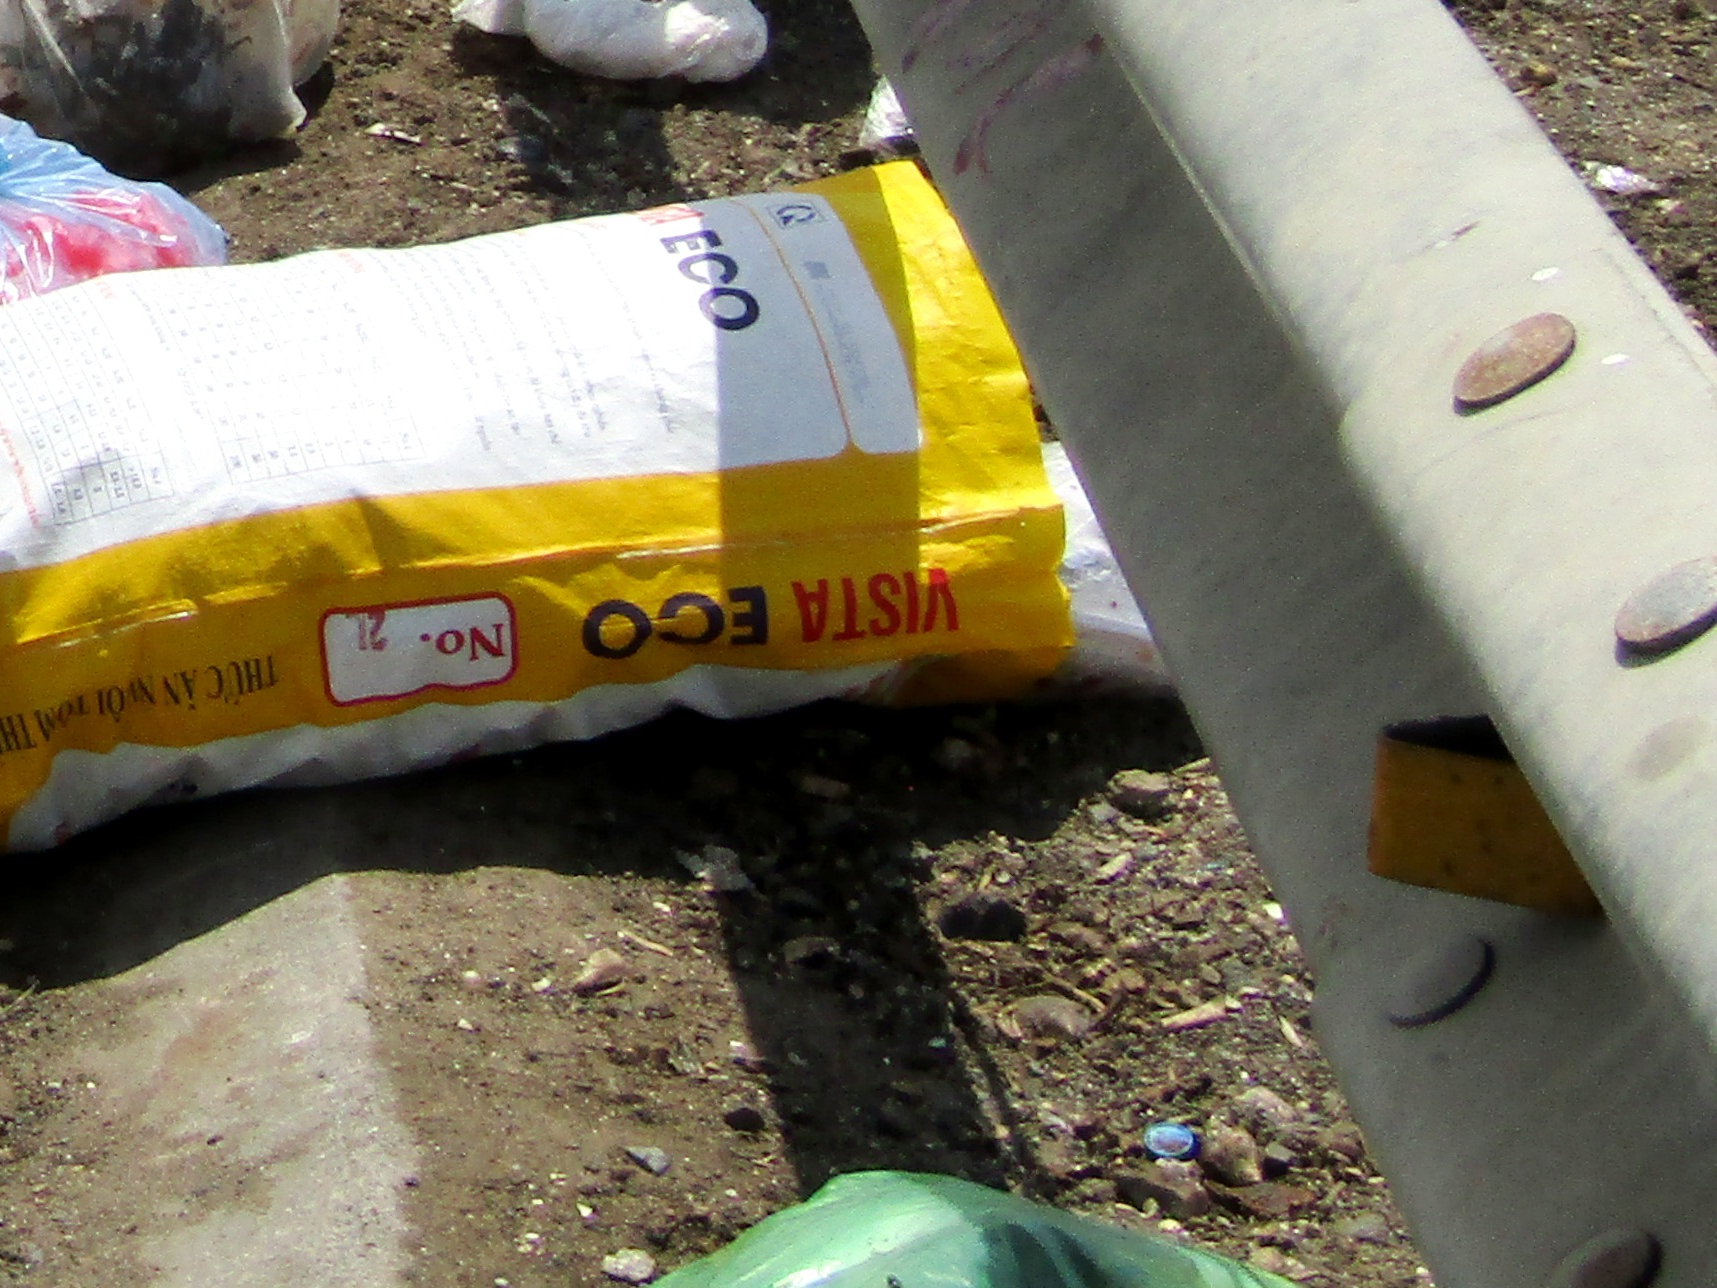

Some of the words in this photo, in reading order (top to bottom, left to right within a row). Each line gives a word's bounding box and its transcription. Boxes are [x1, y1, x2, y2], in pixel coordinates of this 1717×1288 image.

[659, 228, 761, 332] ECO
[419, 622, 507, 662] No.
[581, 584, 771, 661] ECO
[791, 567, 961, 645] VISTA
[205, 654, 280, 705] THỨC
